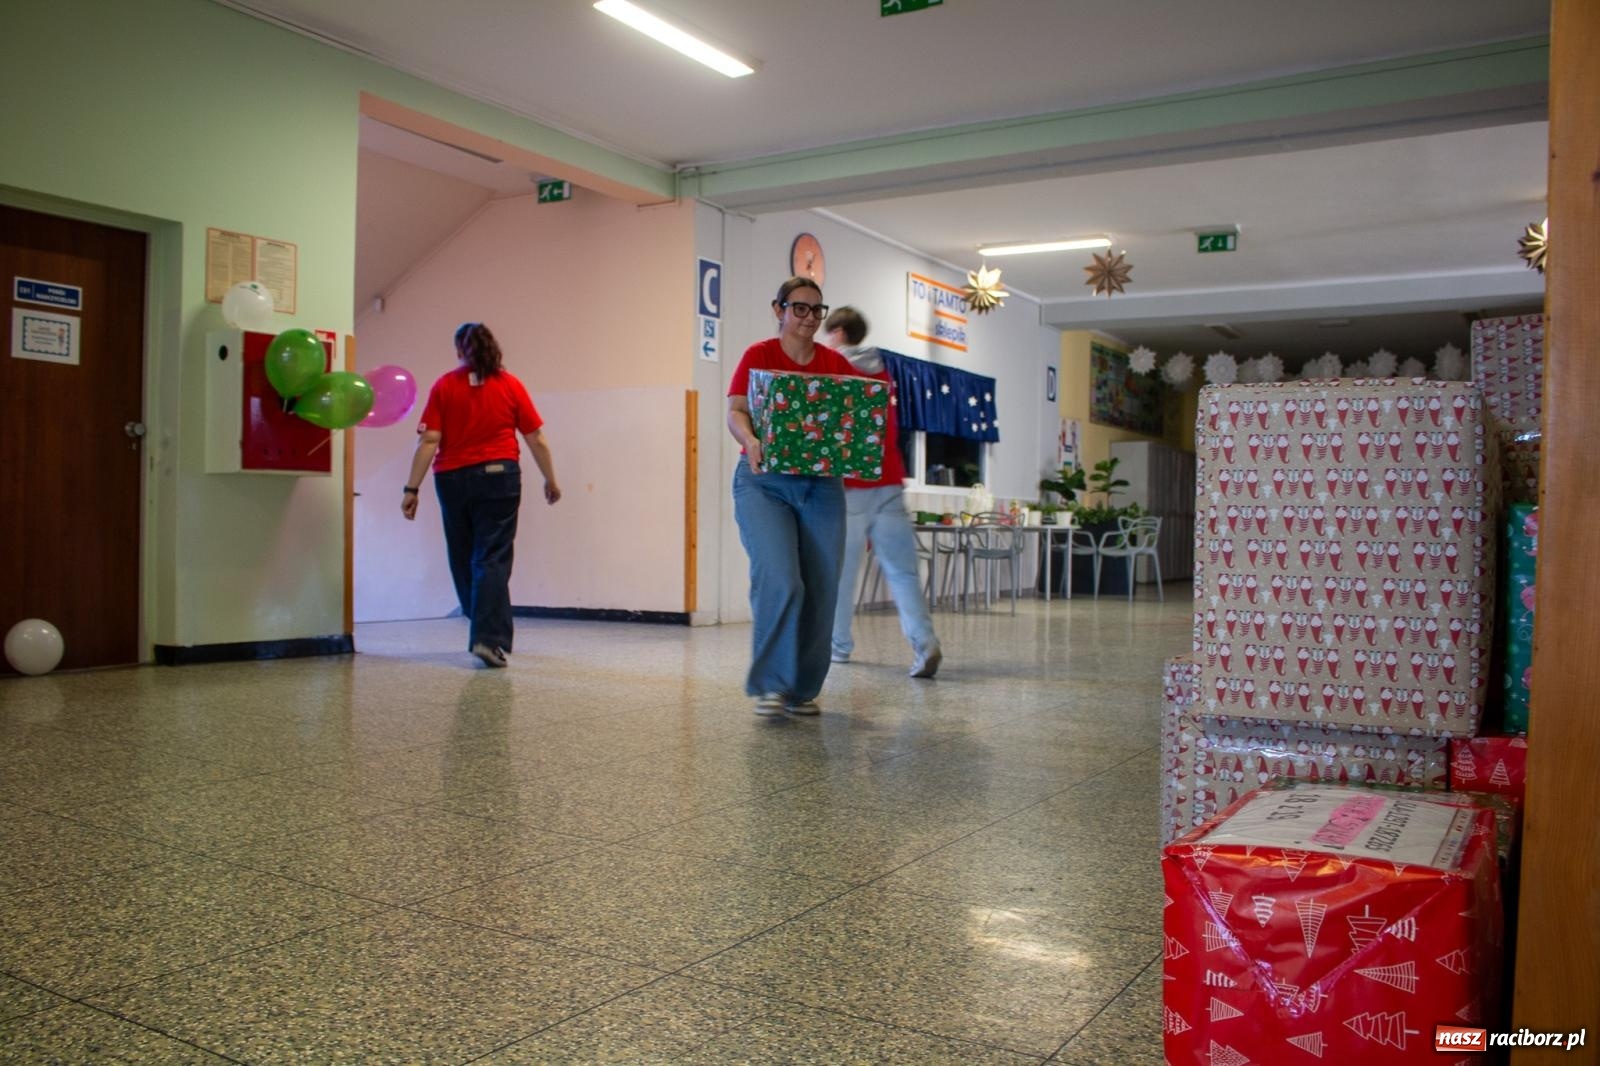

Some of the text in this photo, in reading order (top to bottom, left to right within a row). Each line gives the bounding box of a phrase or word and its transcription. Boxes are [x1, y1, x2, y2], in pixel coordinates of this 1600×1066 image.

[702, 268, 718, 314] C
[912, 281, 925, 299] TO
[932, 288, 966, 314] TAMTO
[1048, 369, 1055, 399] D
